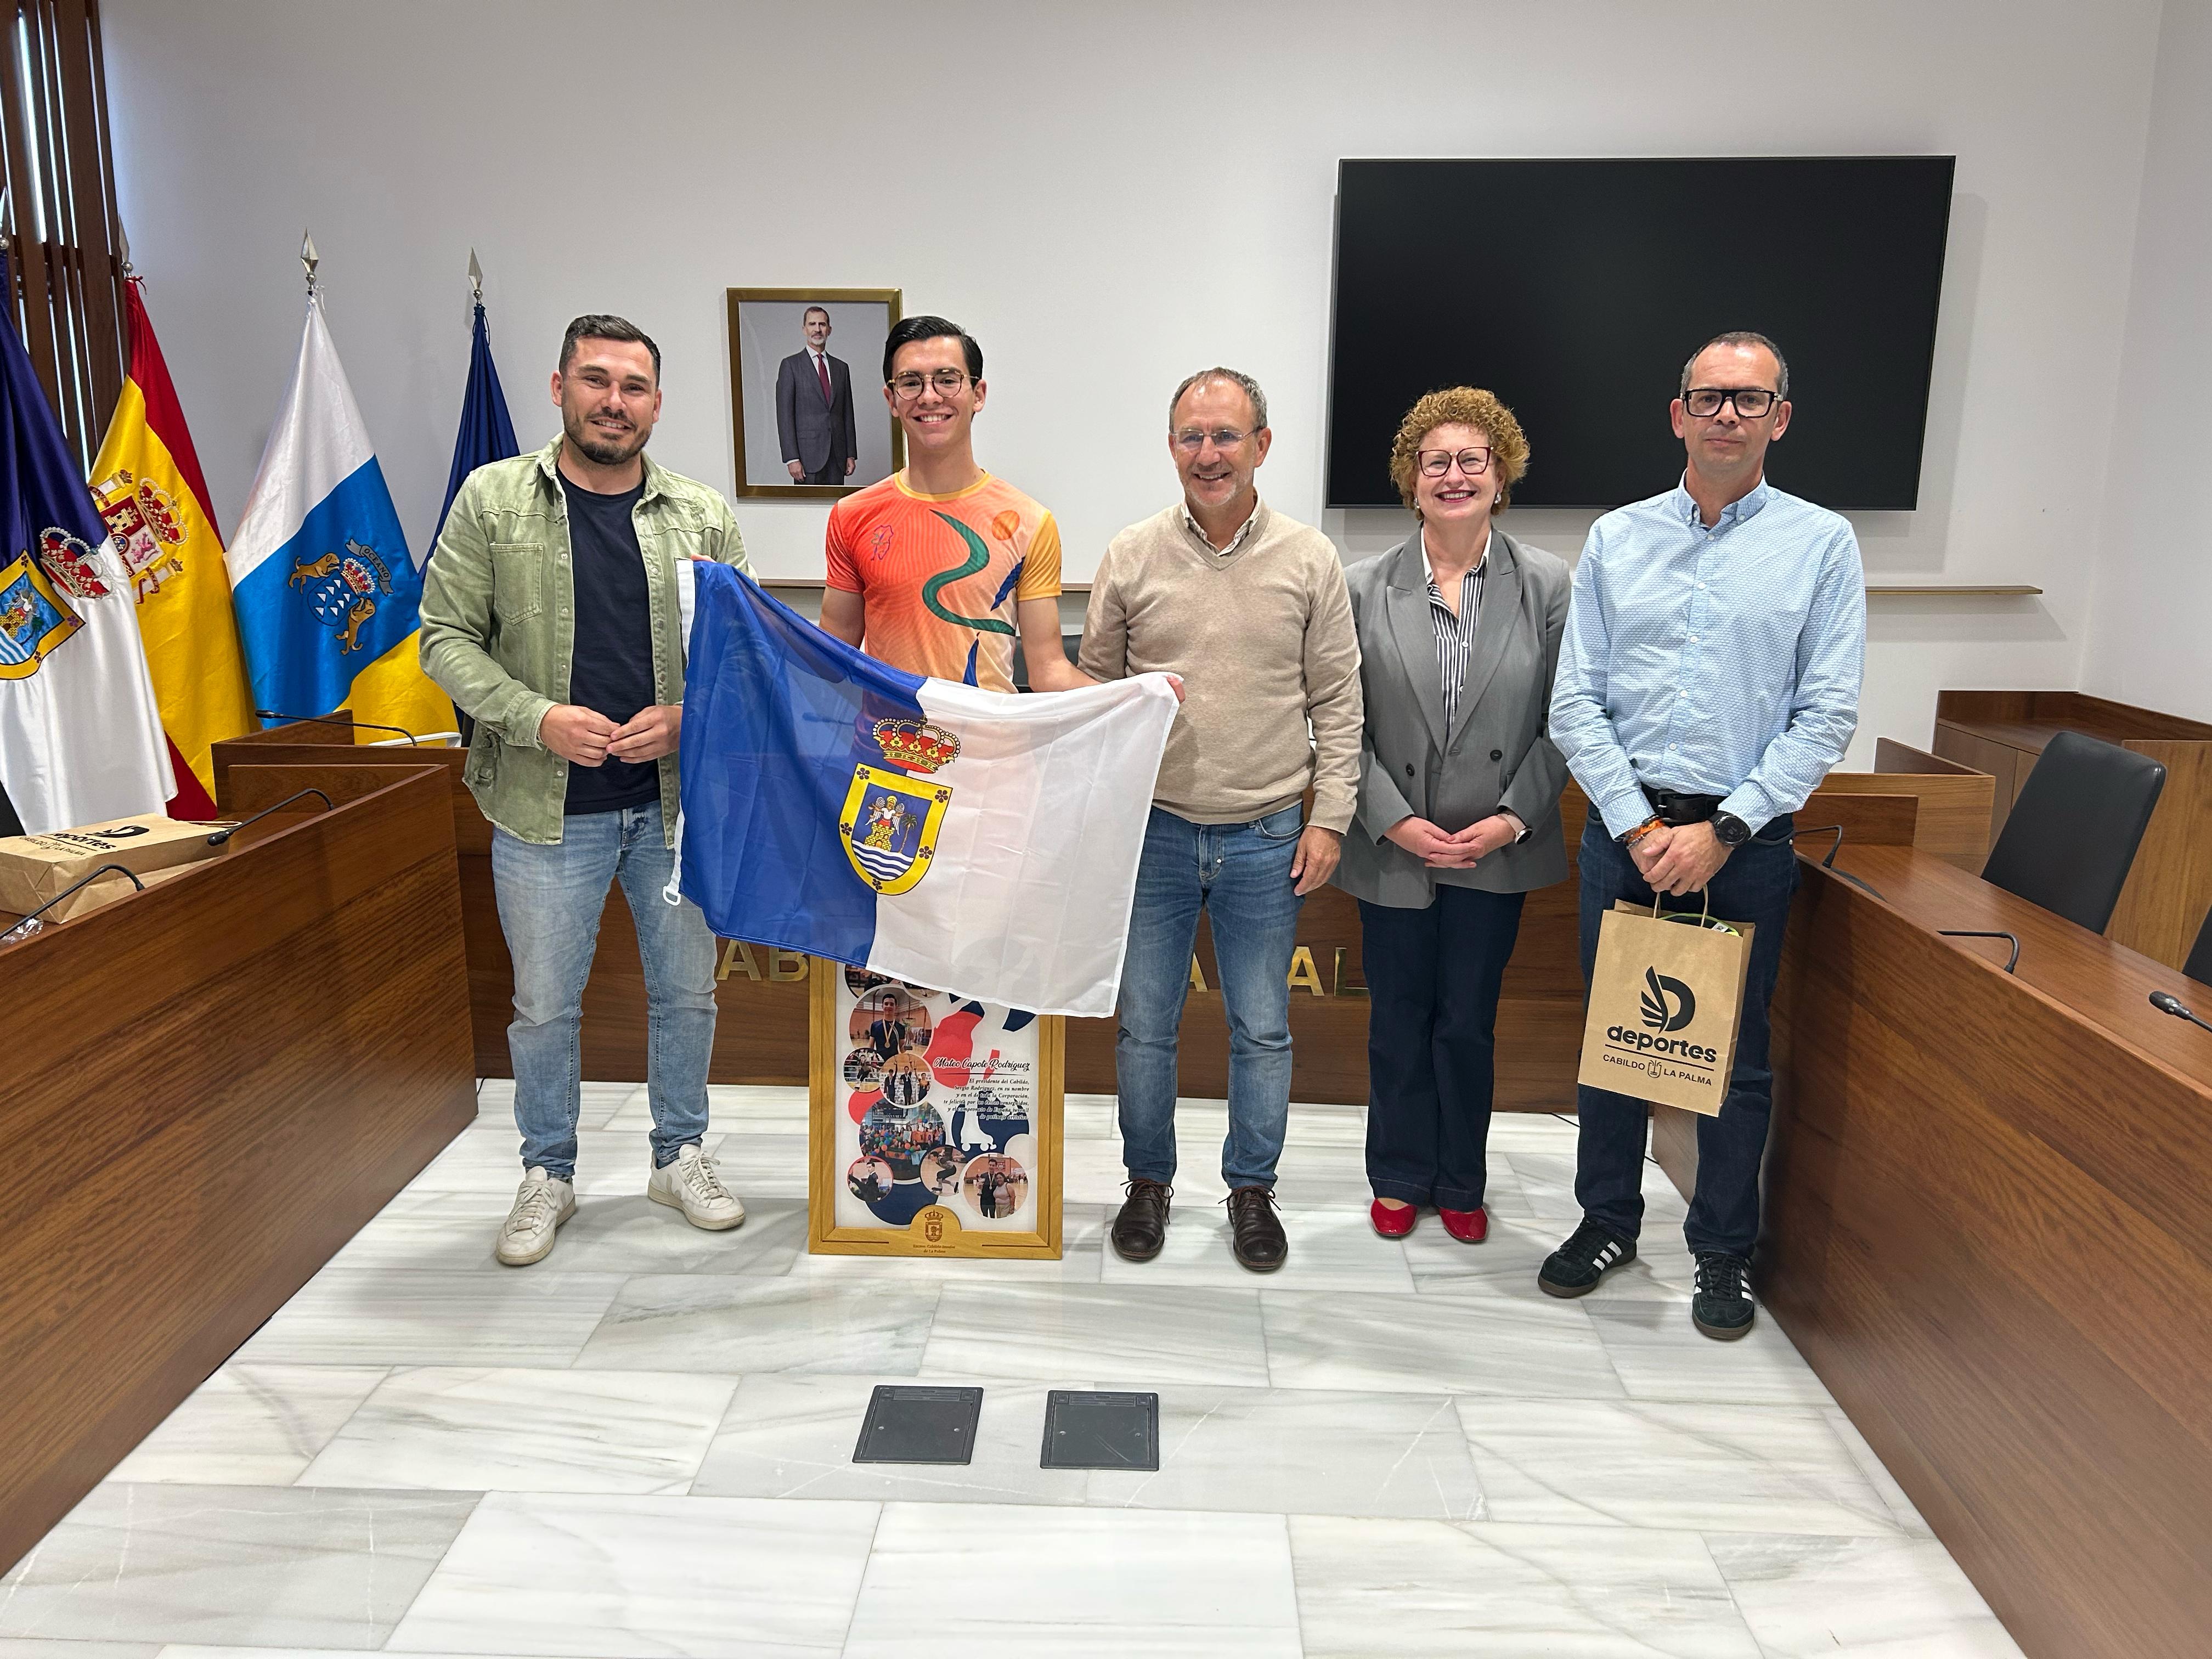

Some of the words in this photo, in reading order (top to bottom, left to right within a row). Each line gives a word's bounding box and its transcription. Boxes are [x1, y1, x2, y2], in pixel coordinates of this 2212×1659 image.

[364, 548, 389, 578] OCEANO
[1607, 1025, 1717, 1063] deportes
[934, 1057, 960, 1068] Mateo
[962, 1058, 988, 1070] Capote
[989, 1059, 1030, 1071] Rodríguez
[1603, 1054, 1645, 1070] CABILDO
[1663, 1068, 1677, 1077] LA
[1679, 1071, 1712, 1086] PALMA
